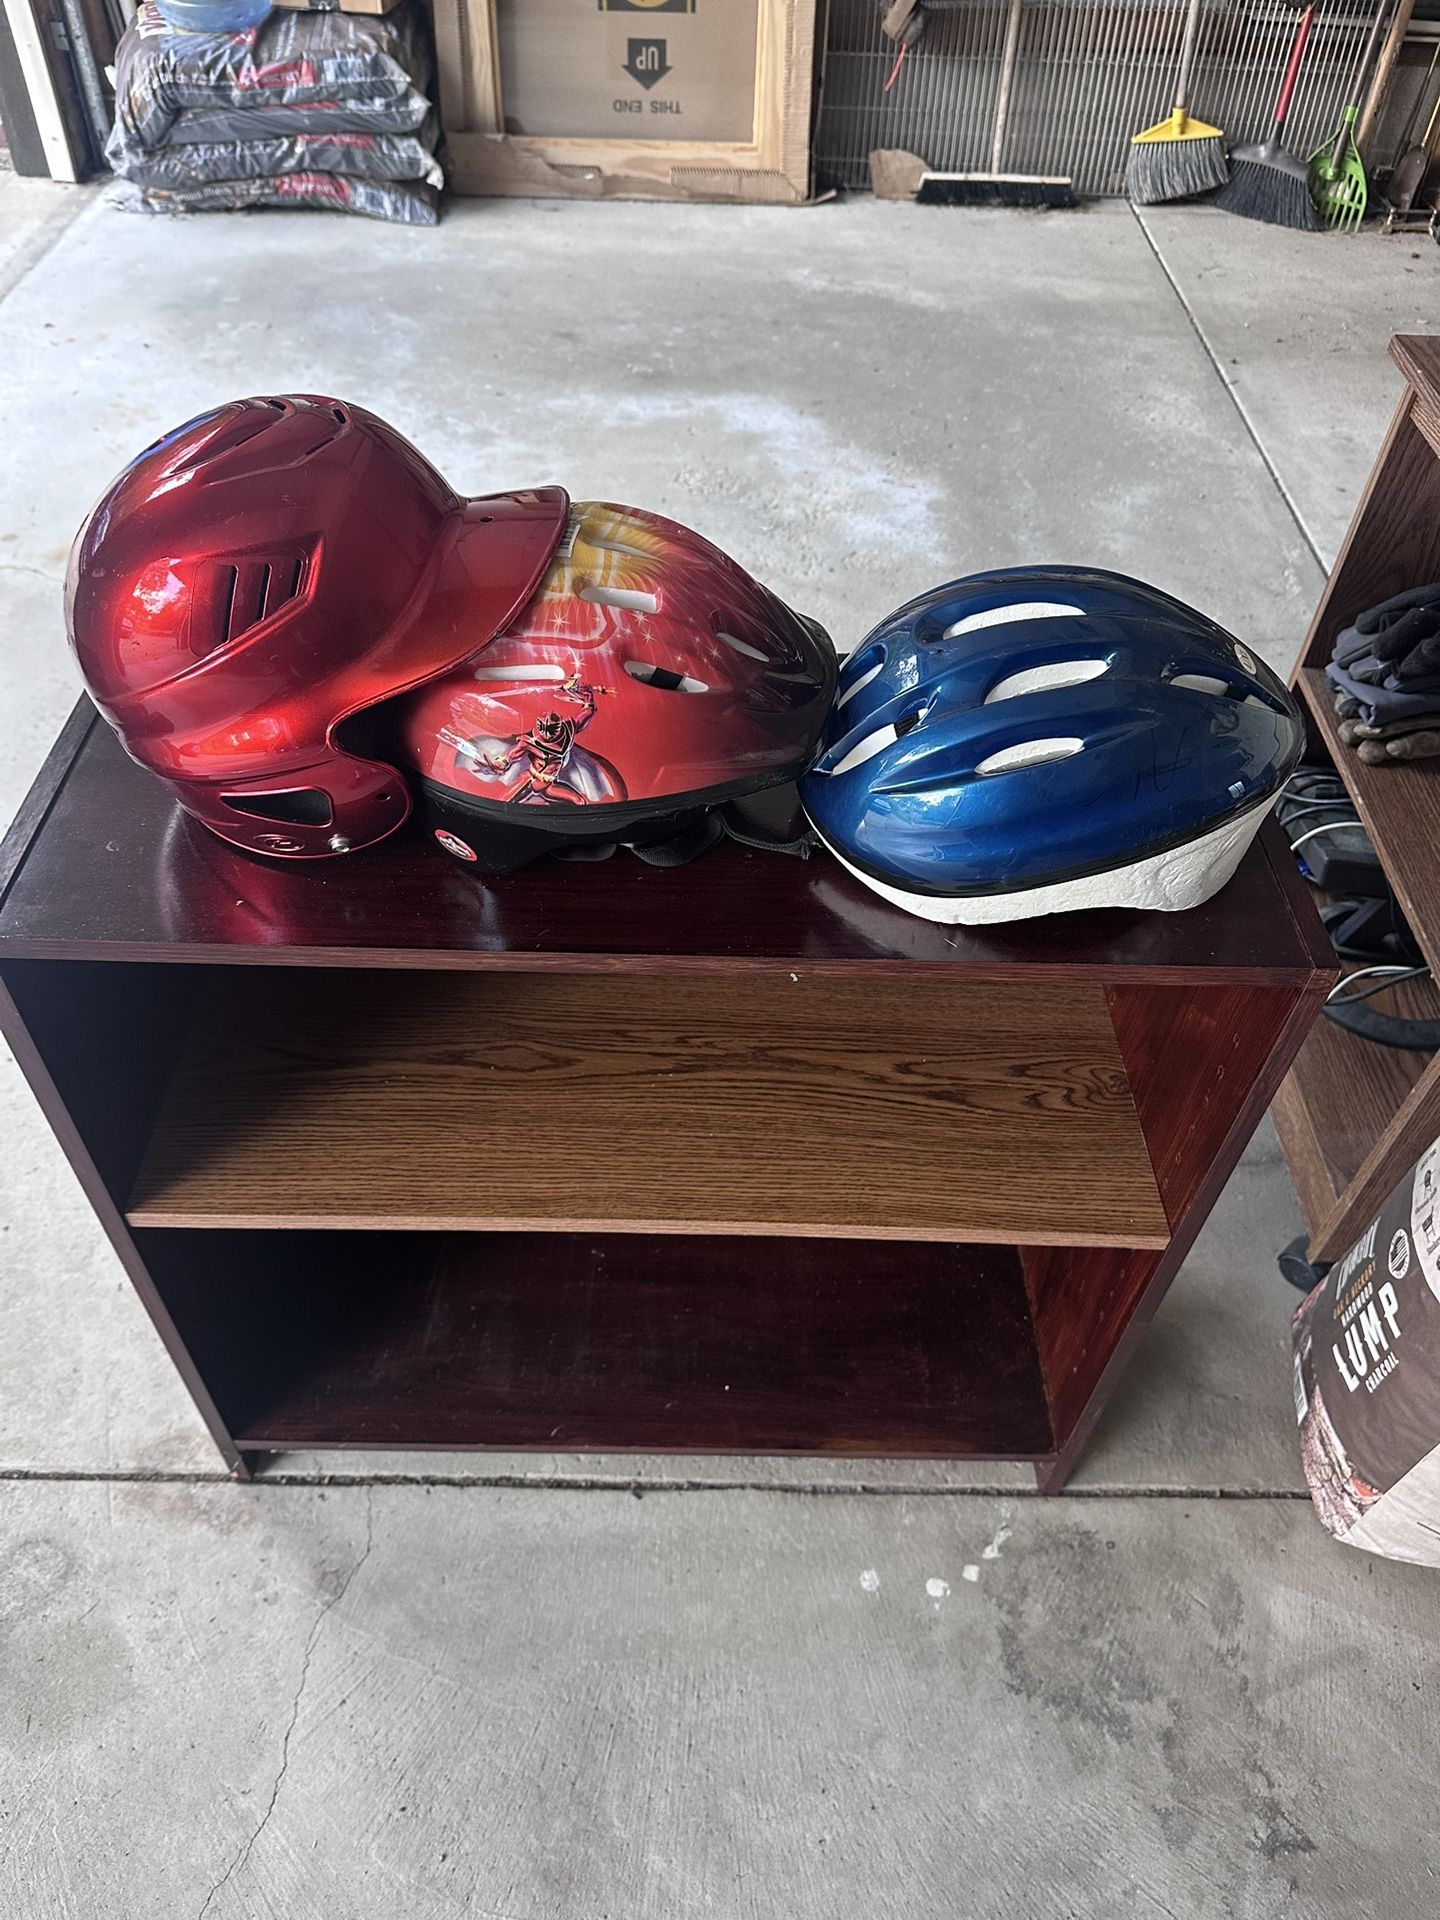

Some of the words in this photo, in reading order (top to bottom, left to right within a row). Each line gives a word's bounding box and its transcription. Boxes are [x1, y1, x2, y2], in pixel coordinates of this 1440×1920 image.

[636, 46, 659, 71] UP
[613, 100, 642, 113] END
[650, 100, 682, 114] THIS
[1340, 1281, 1373, 1328] HARDWOOD
[1332, 1281, 1401, 1393] LUMP
[1365, 1351, 1400, 1393] CHARCOAL
